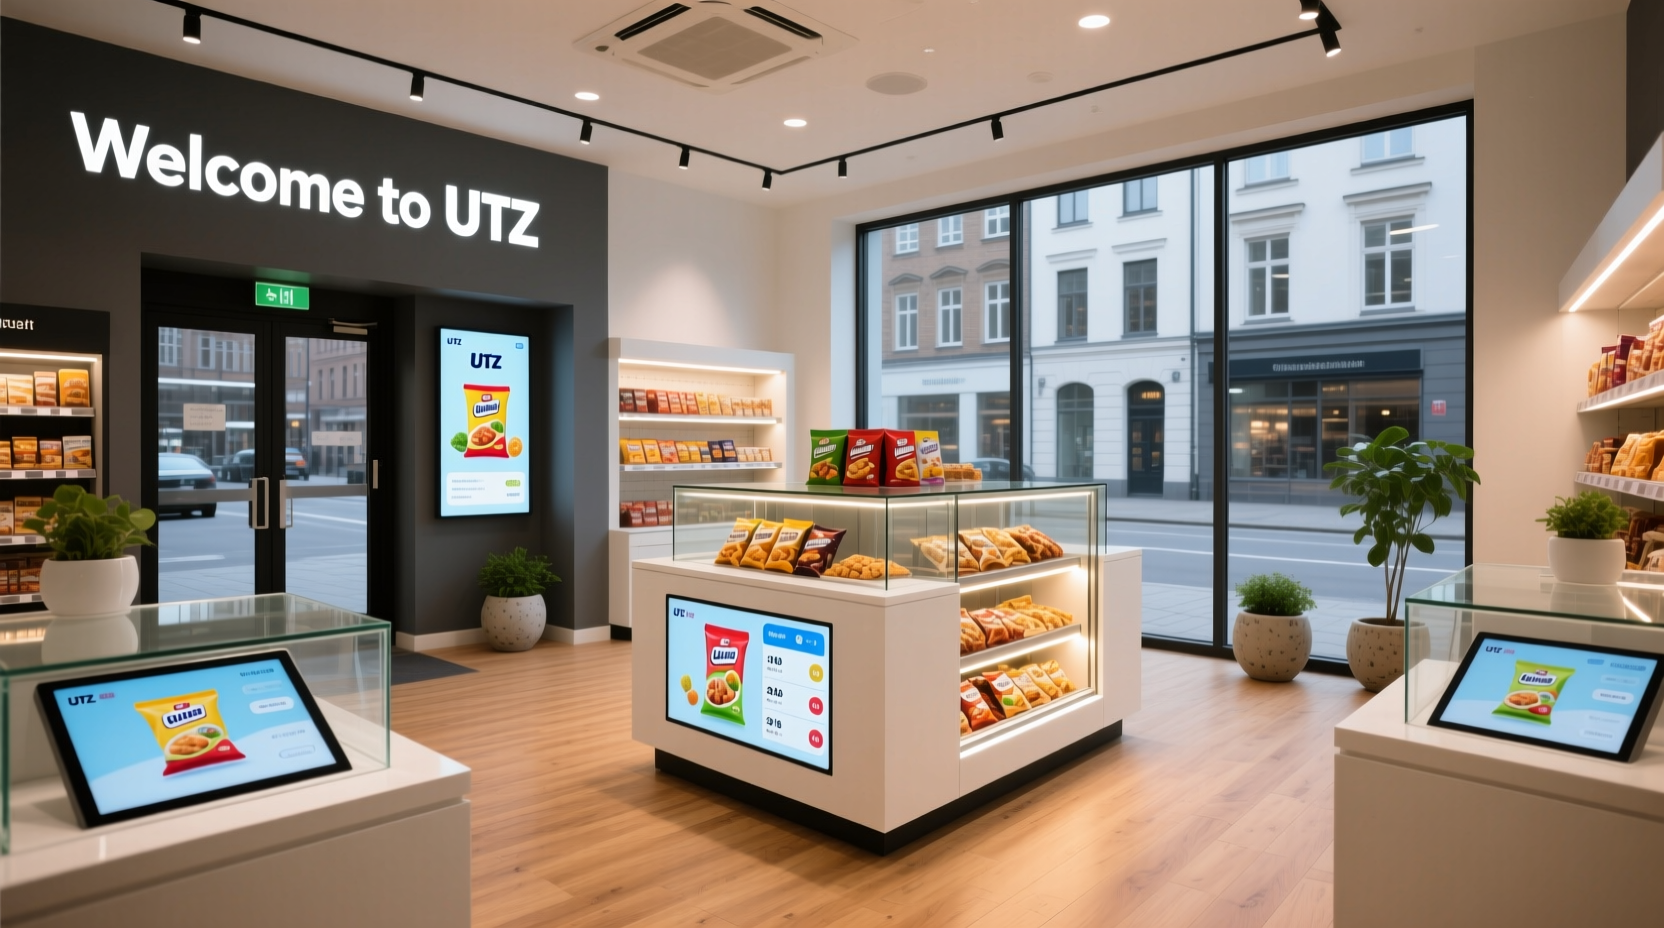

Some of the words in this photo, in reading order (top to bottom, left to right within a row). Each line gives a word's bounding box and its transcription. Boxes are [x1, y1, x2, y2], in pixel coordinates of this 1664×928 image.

[70, 111, 365, 218] Welcome
[377, 178, 431, 229] to
[445, 185, 540, 248] UTZ
[470, 352, 502, 369] UTZ
[68, 694, 96, 706] UTZ
